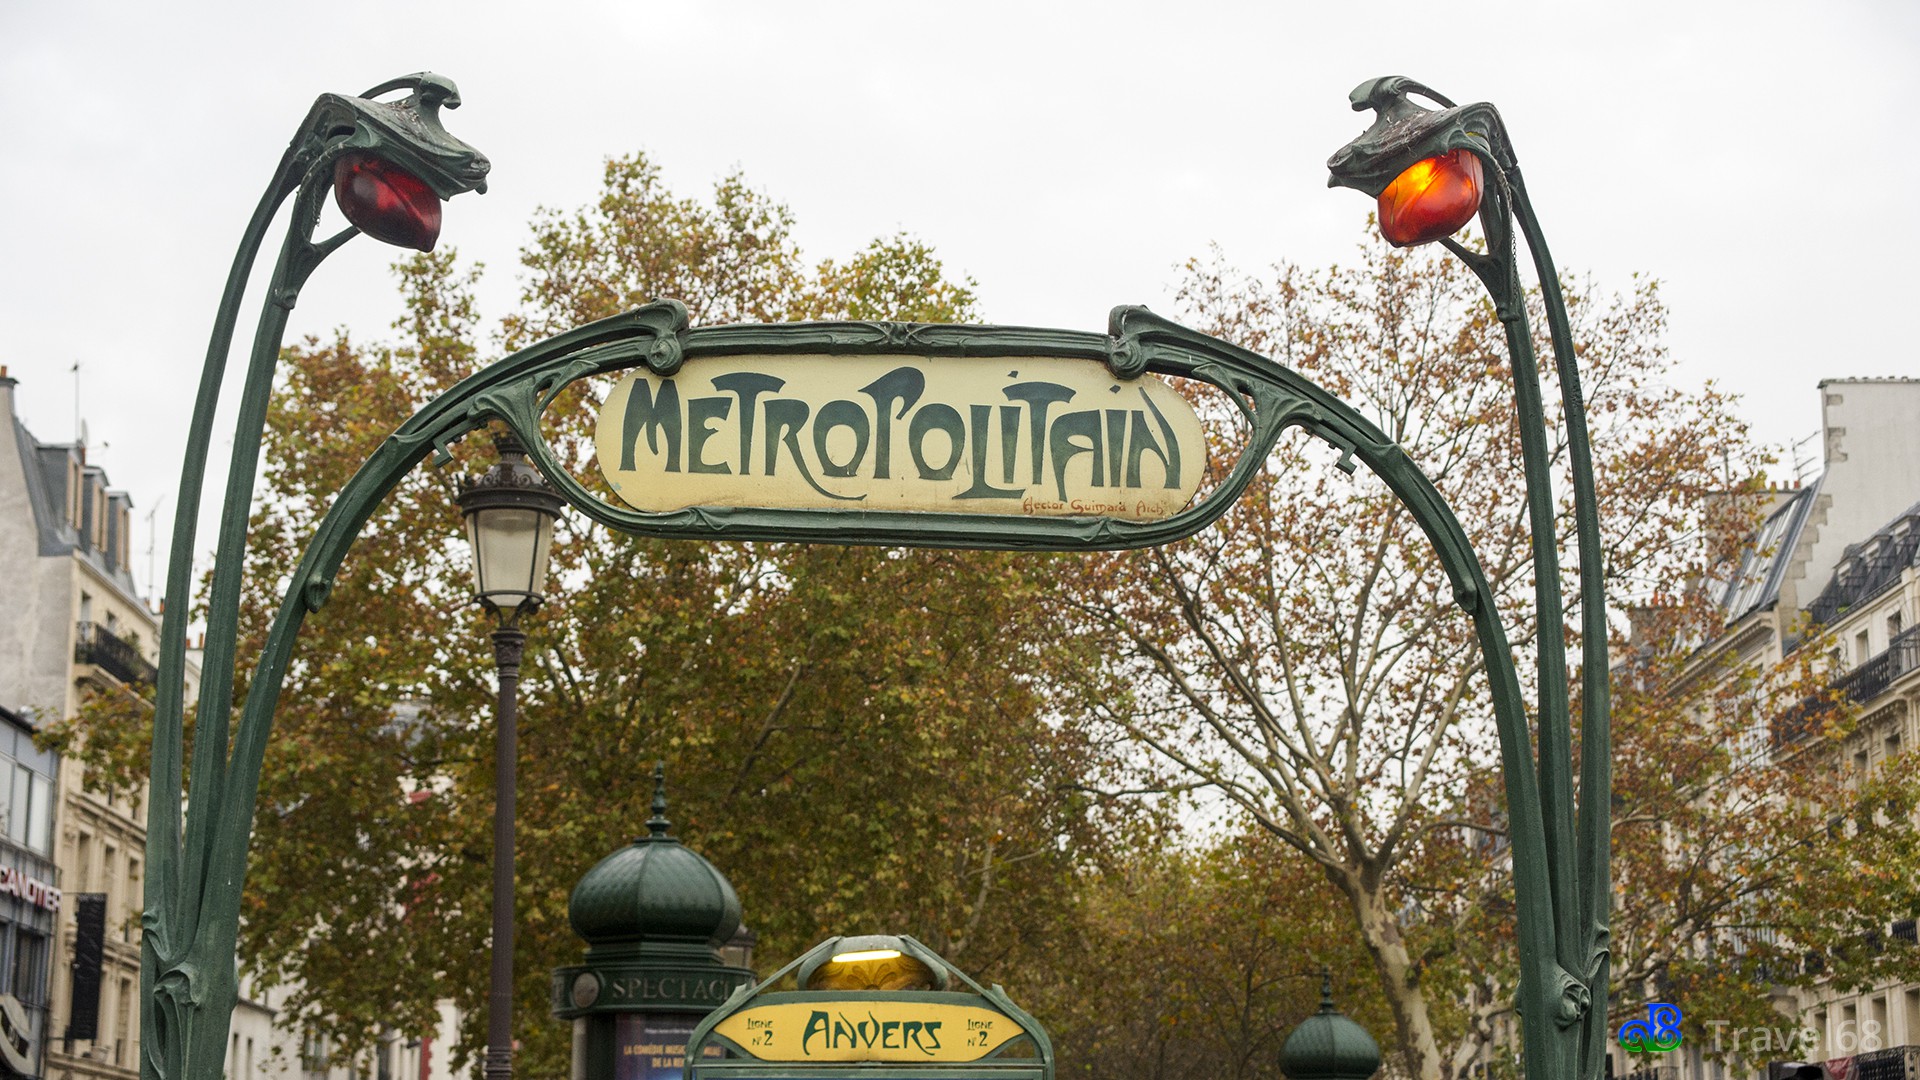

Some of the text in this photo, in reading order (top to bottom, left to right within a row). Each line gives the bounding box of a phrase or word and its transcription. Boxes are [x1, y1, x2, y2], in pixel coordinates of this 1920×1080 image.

[618, 366, 1182, 500] METROPOLITAIN
[1022, 496, 1064, 515] Hector
[1070, 499, 1127, 516] Guimard
[612, 977, 730, 1001] SPECTACL
[764, 1030, 773, 1046] 2
[802, 1010, 942, 1056] ANVERS
[979, 1030, 988, 1047] 2
